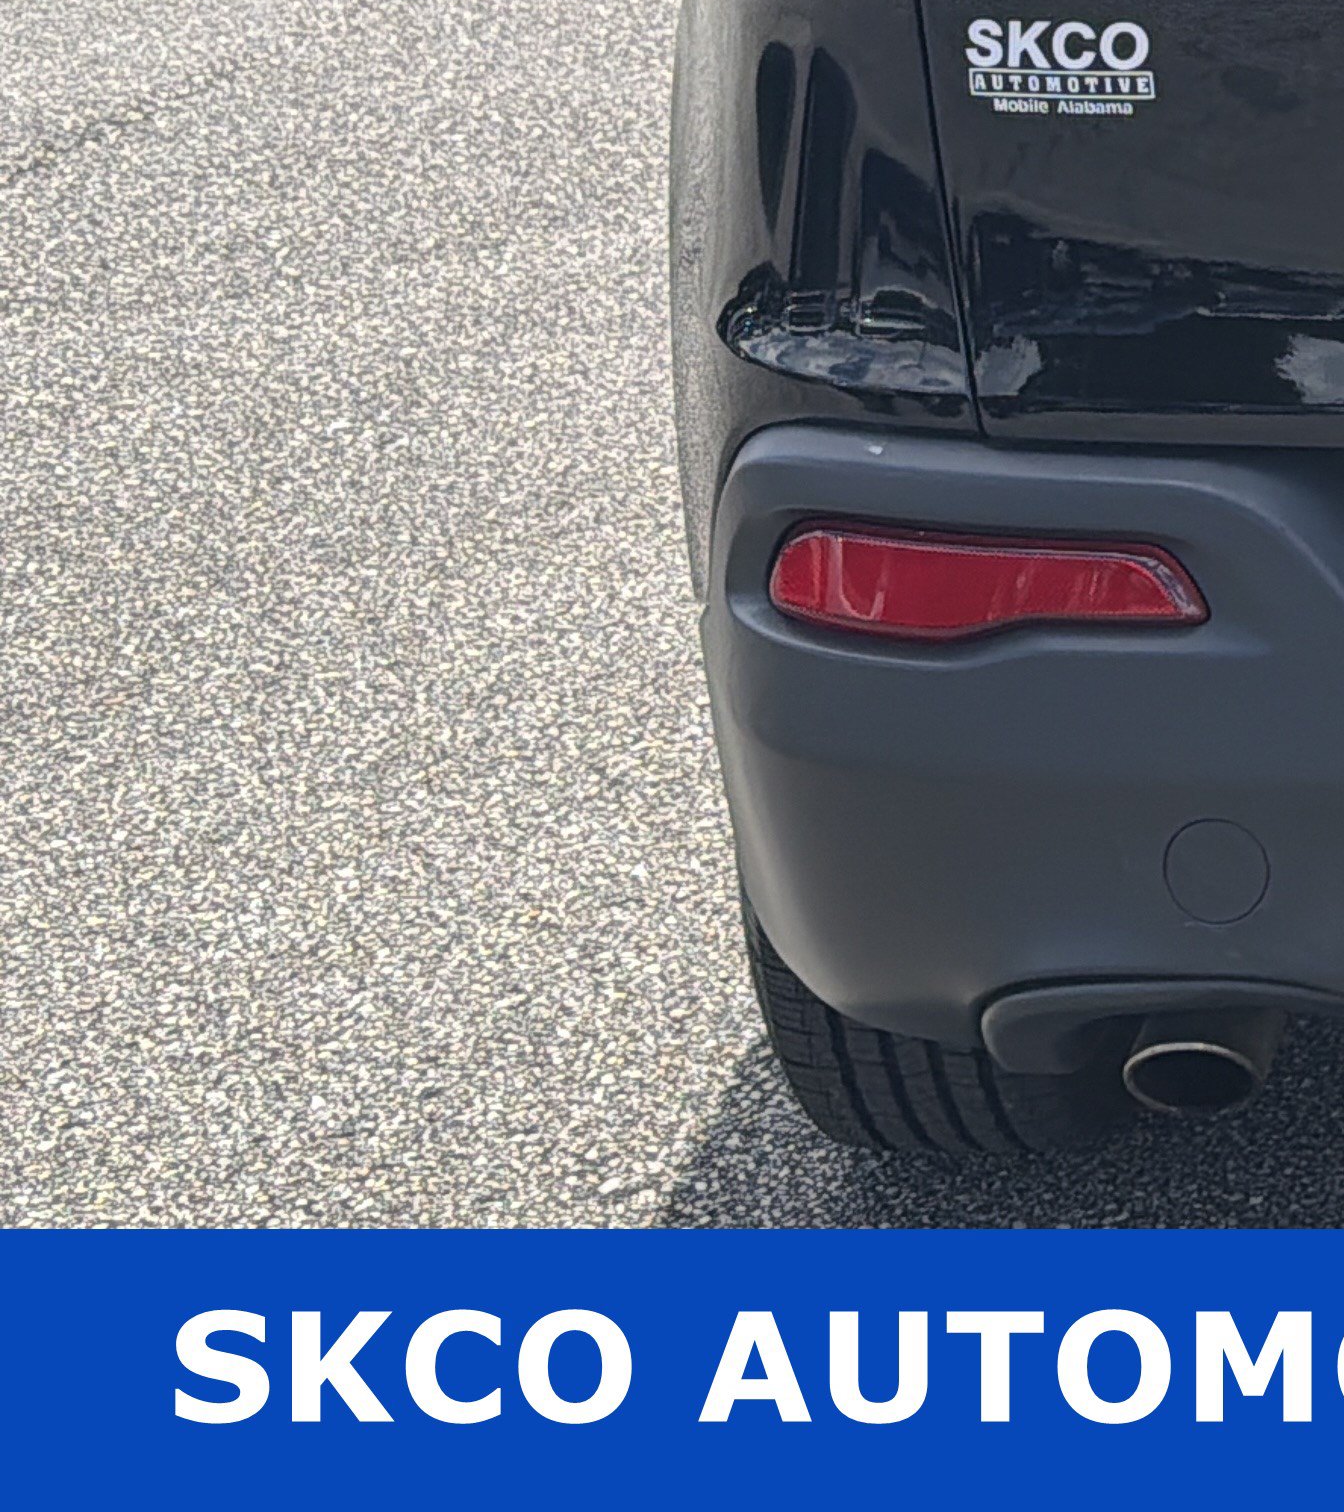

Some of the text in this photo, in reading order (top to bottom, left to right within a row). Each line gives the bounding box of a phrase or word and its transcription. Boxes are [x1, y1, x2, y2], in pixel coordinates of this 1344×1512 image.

[965, 19, 1149, 70] SKCO
[974, 73, 1150, 93] AUTOMOTIVE
[993, 97, 1135, 116] Mobile Alabama
